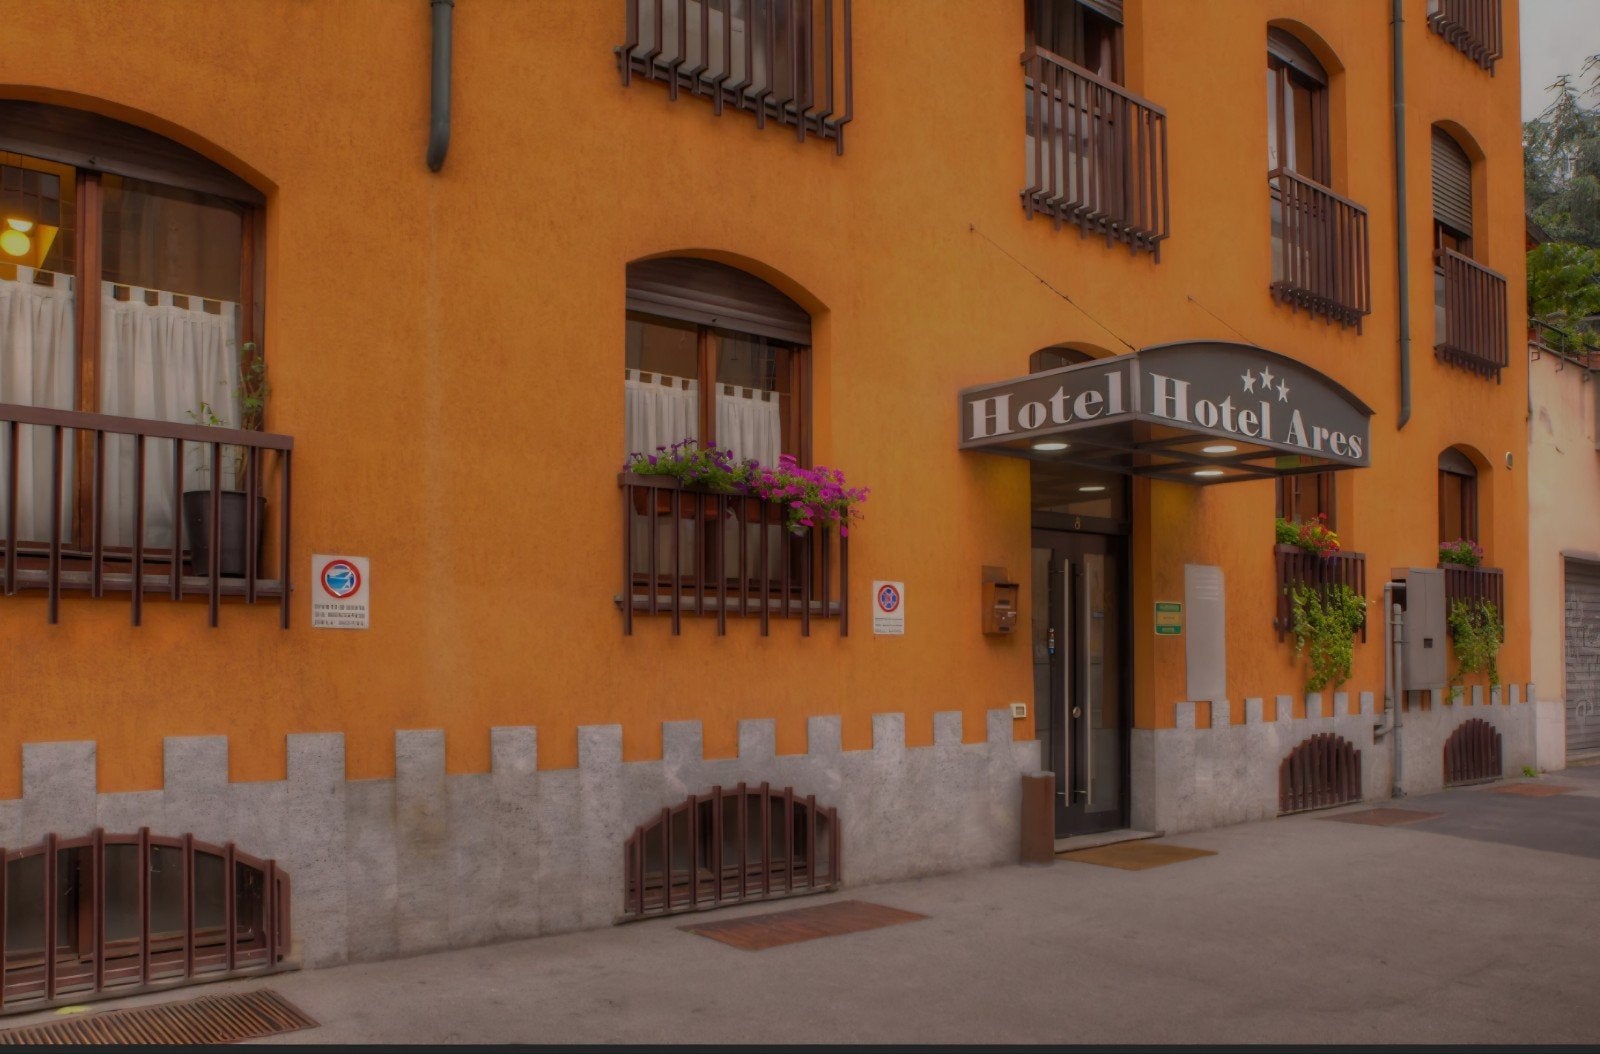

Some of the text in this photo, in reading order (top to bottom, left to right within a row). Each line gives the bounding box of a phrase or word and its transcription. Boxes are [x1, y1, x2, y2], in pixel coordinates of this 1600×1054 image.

[970, 371, 1123, 439] Hotel
[1150, 372, 1362, 459] Hotel Ares
